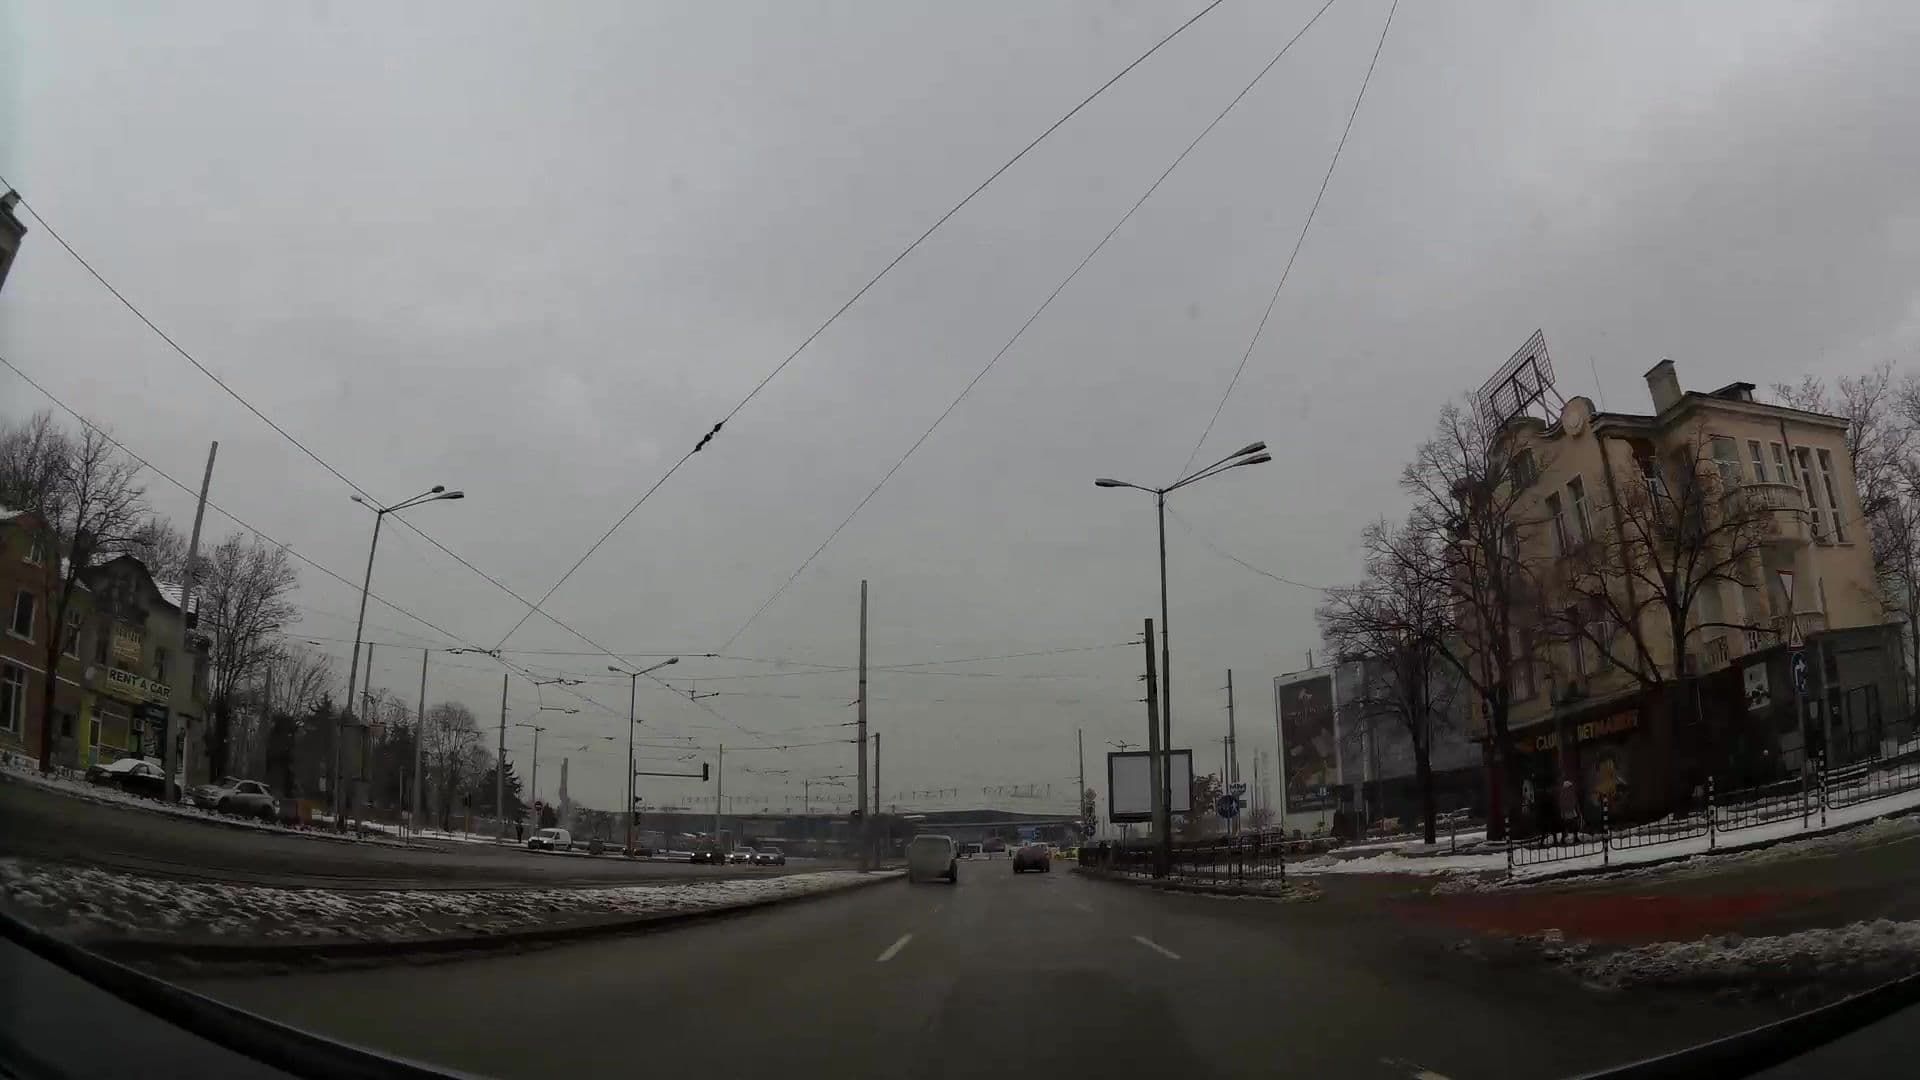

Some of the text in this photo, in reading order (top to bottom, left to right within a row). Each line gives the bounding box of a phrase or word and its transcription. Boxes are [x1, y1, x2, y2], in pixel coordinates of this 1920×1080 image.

[110, 670, 170, 697] RENT A CAR
